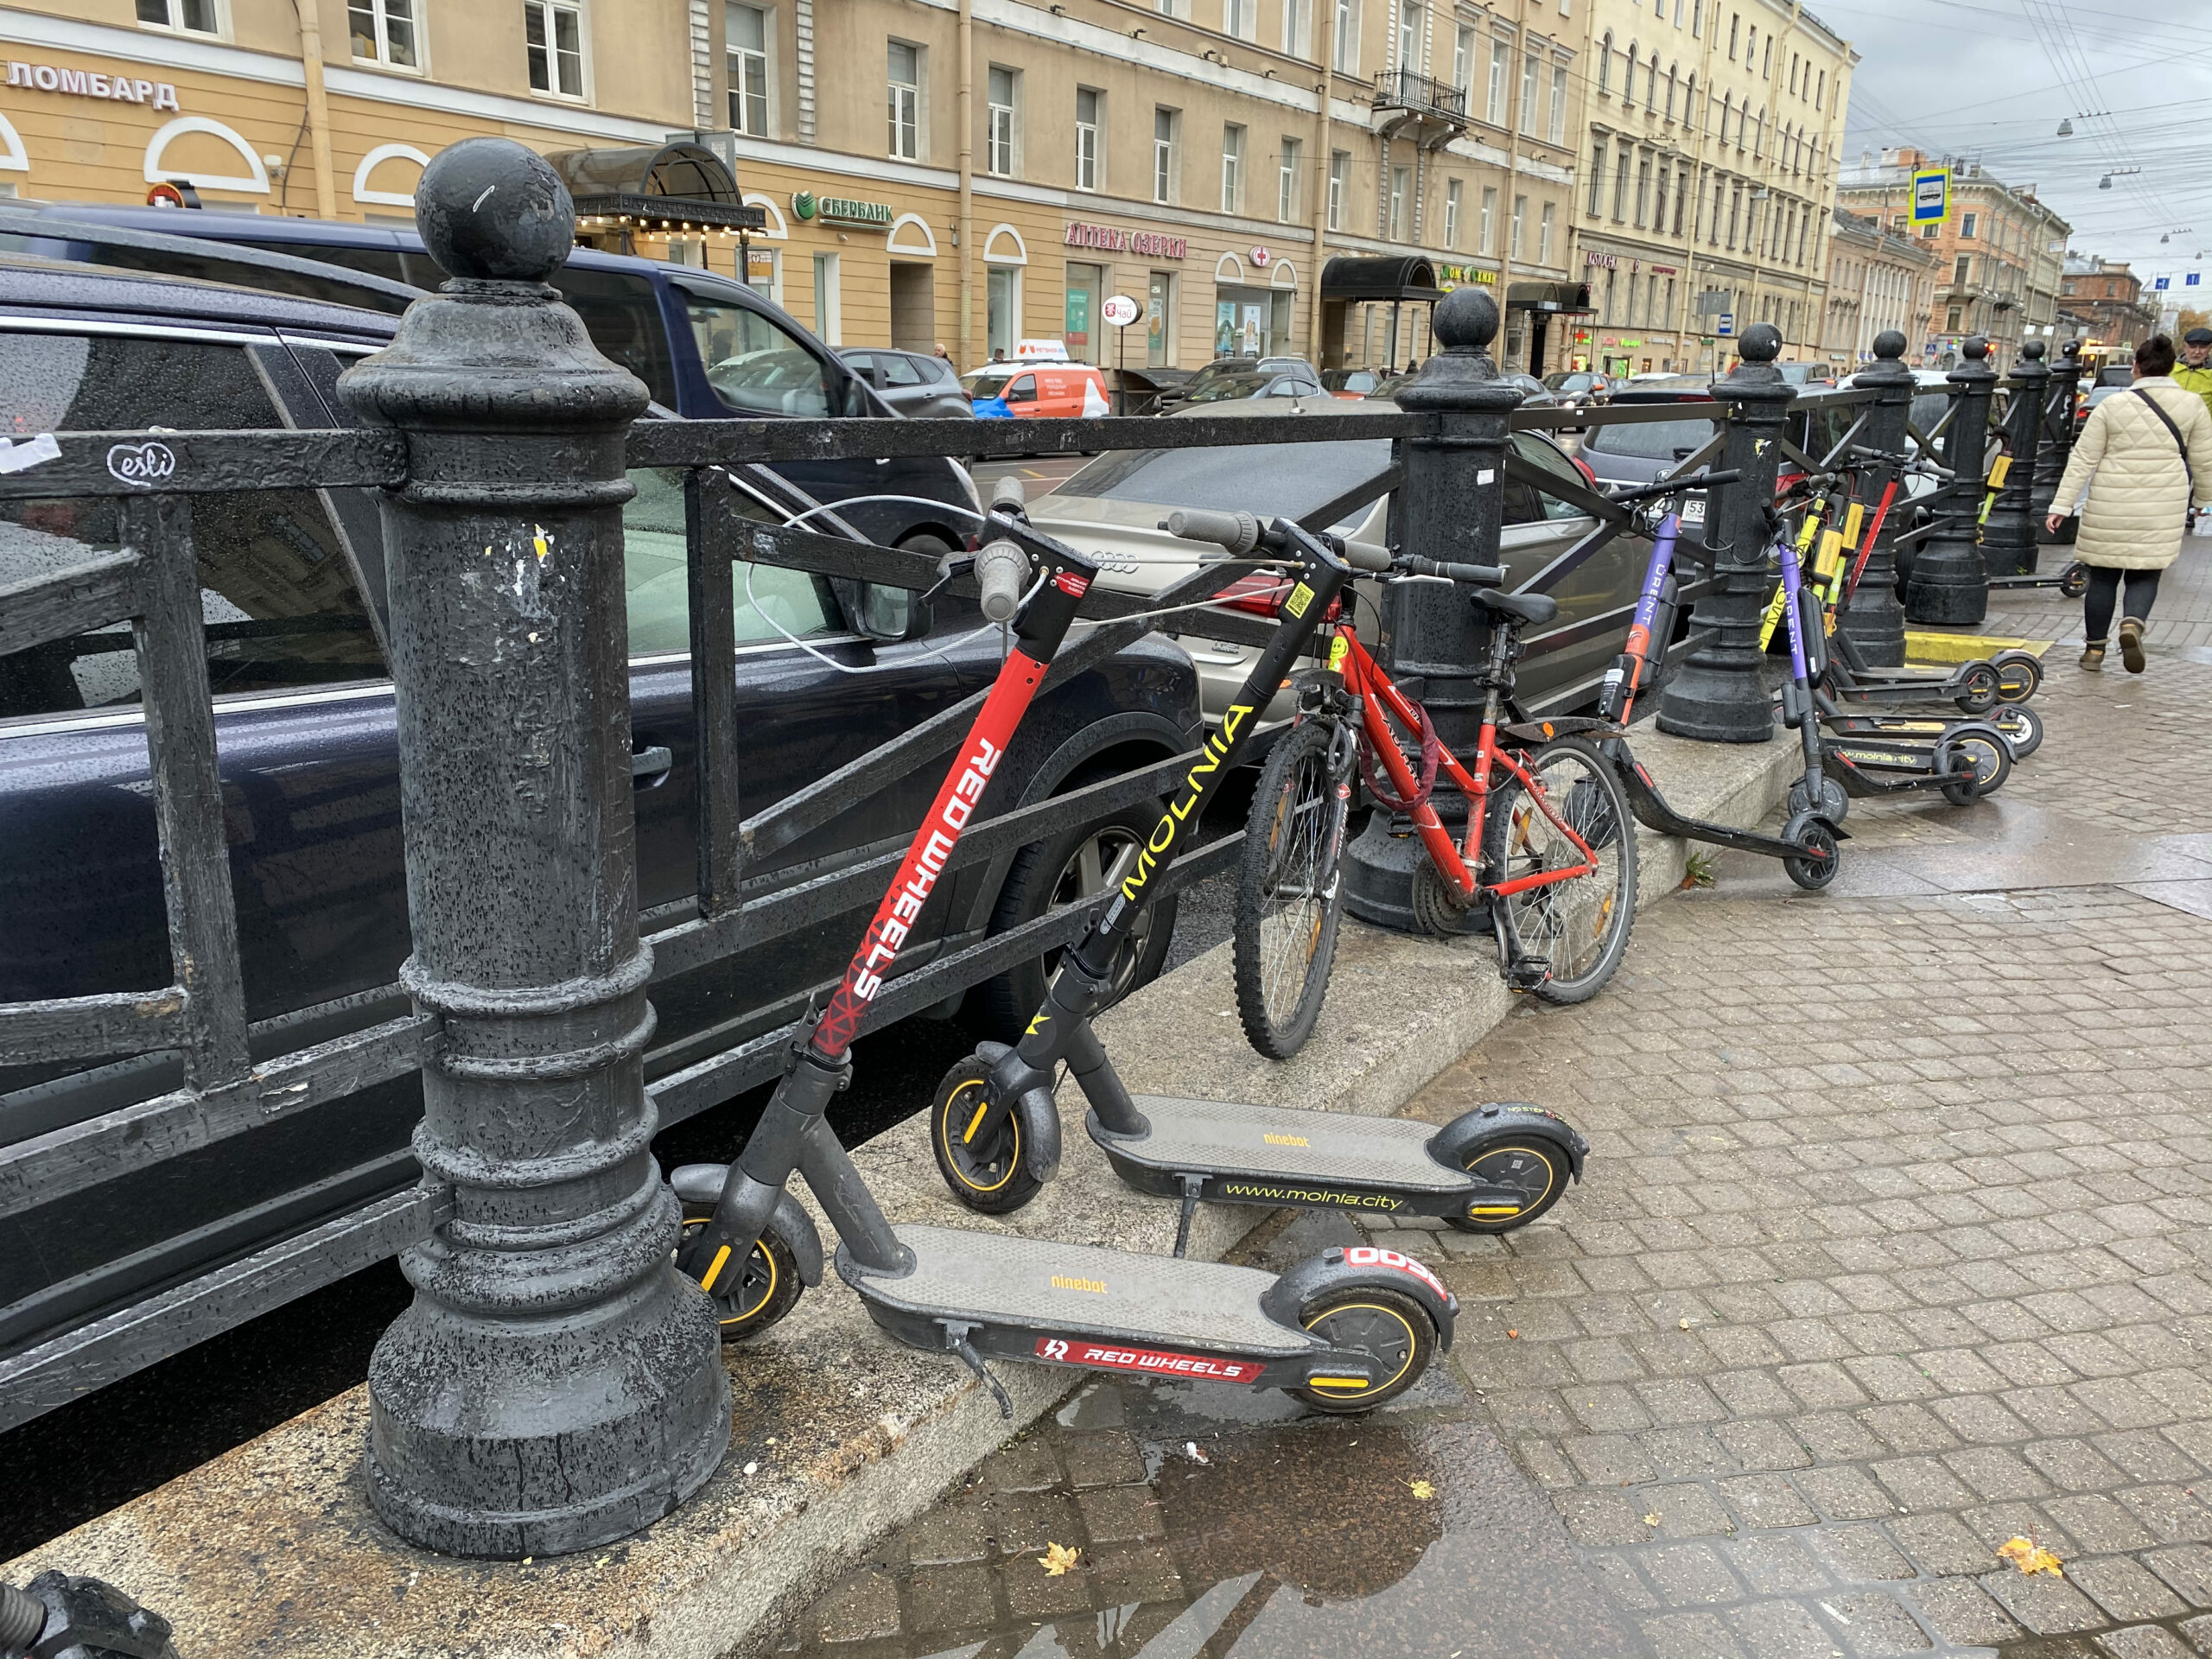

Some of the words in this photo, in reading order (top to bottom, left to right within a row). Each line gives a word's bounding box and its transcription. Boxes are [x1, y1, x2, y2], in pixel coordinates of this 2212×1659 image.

[8, 60, 179, 111] ЛОМБАРД
[820, 196, 894, 222] СБЕРБАНК
[1066, 223, 1127, 250] АПТЕКА
[1132, 232, 1187, 258] ОЗЕРКИ
[1689, 502, 1705, 513] 53
[1382, 718, 1430, 806] AUTHO
[943, 737, 1001, 830] RED
[1122, 704, 1254, 901] MOLNIA
[854, 829, 955, 1001] WHEELS
[1263, 1132, 1310, 1147] ninebot
[1226, 1184, 1403, 1211] www.molnia.city
[1051, 1274, 1108, 1294] ninebot
[1084, 1348, 1137, 1364] RED
[1138, 1355, 1243, 1377] WHEELS
